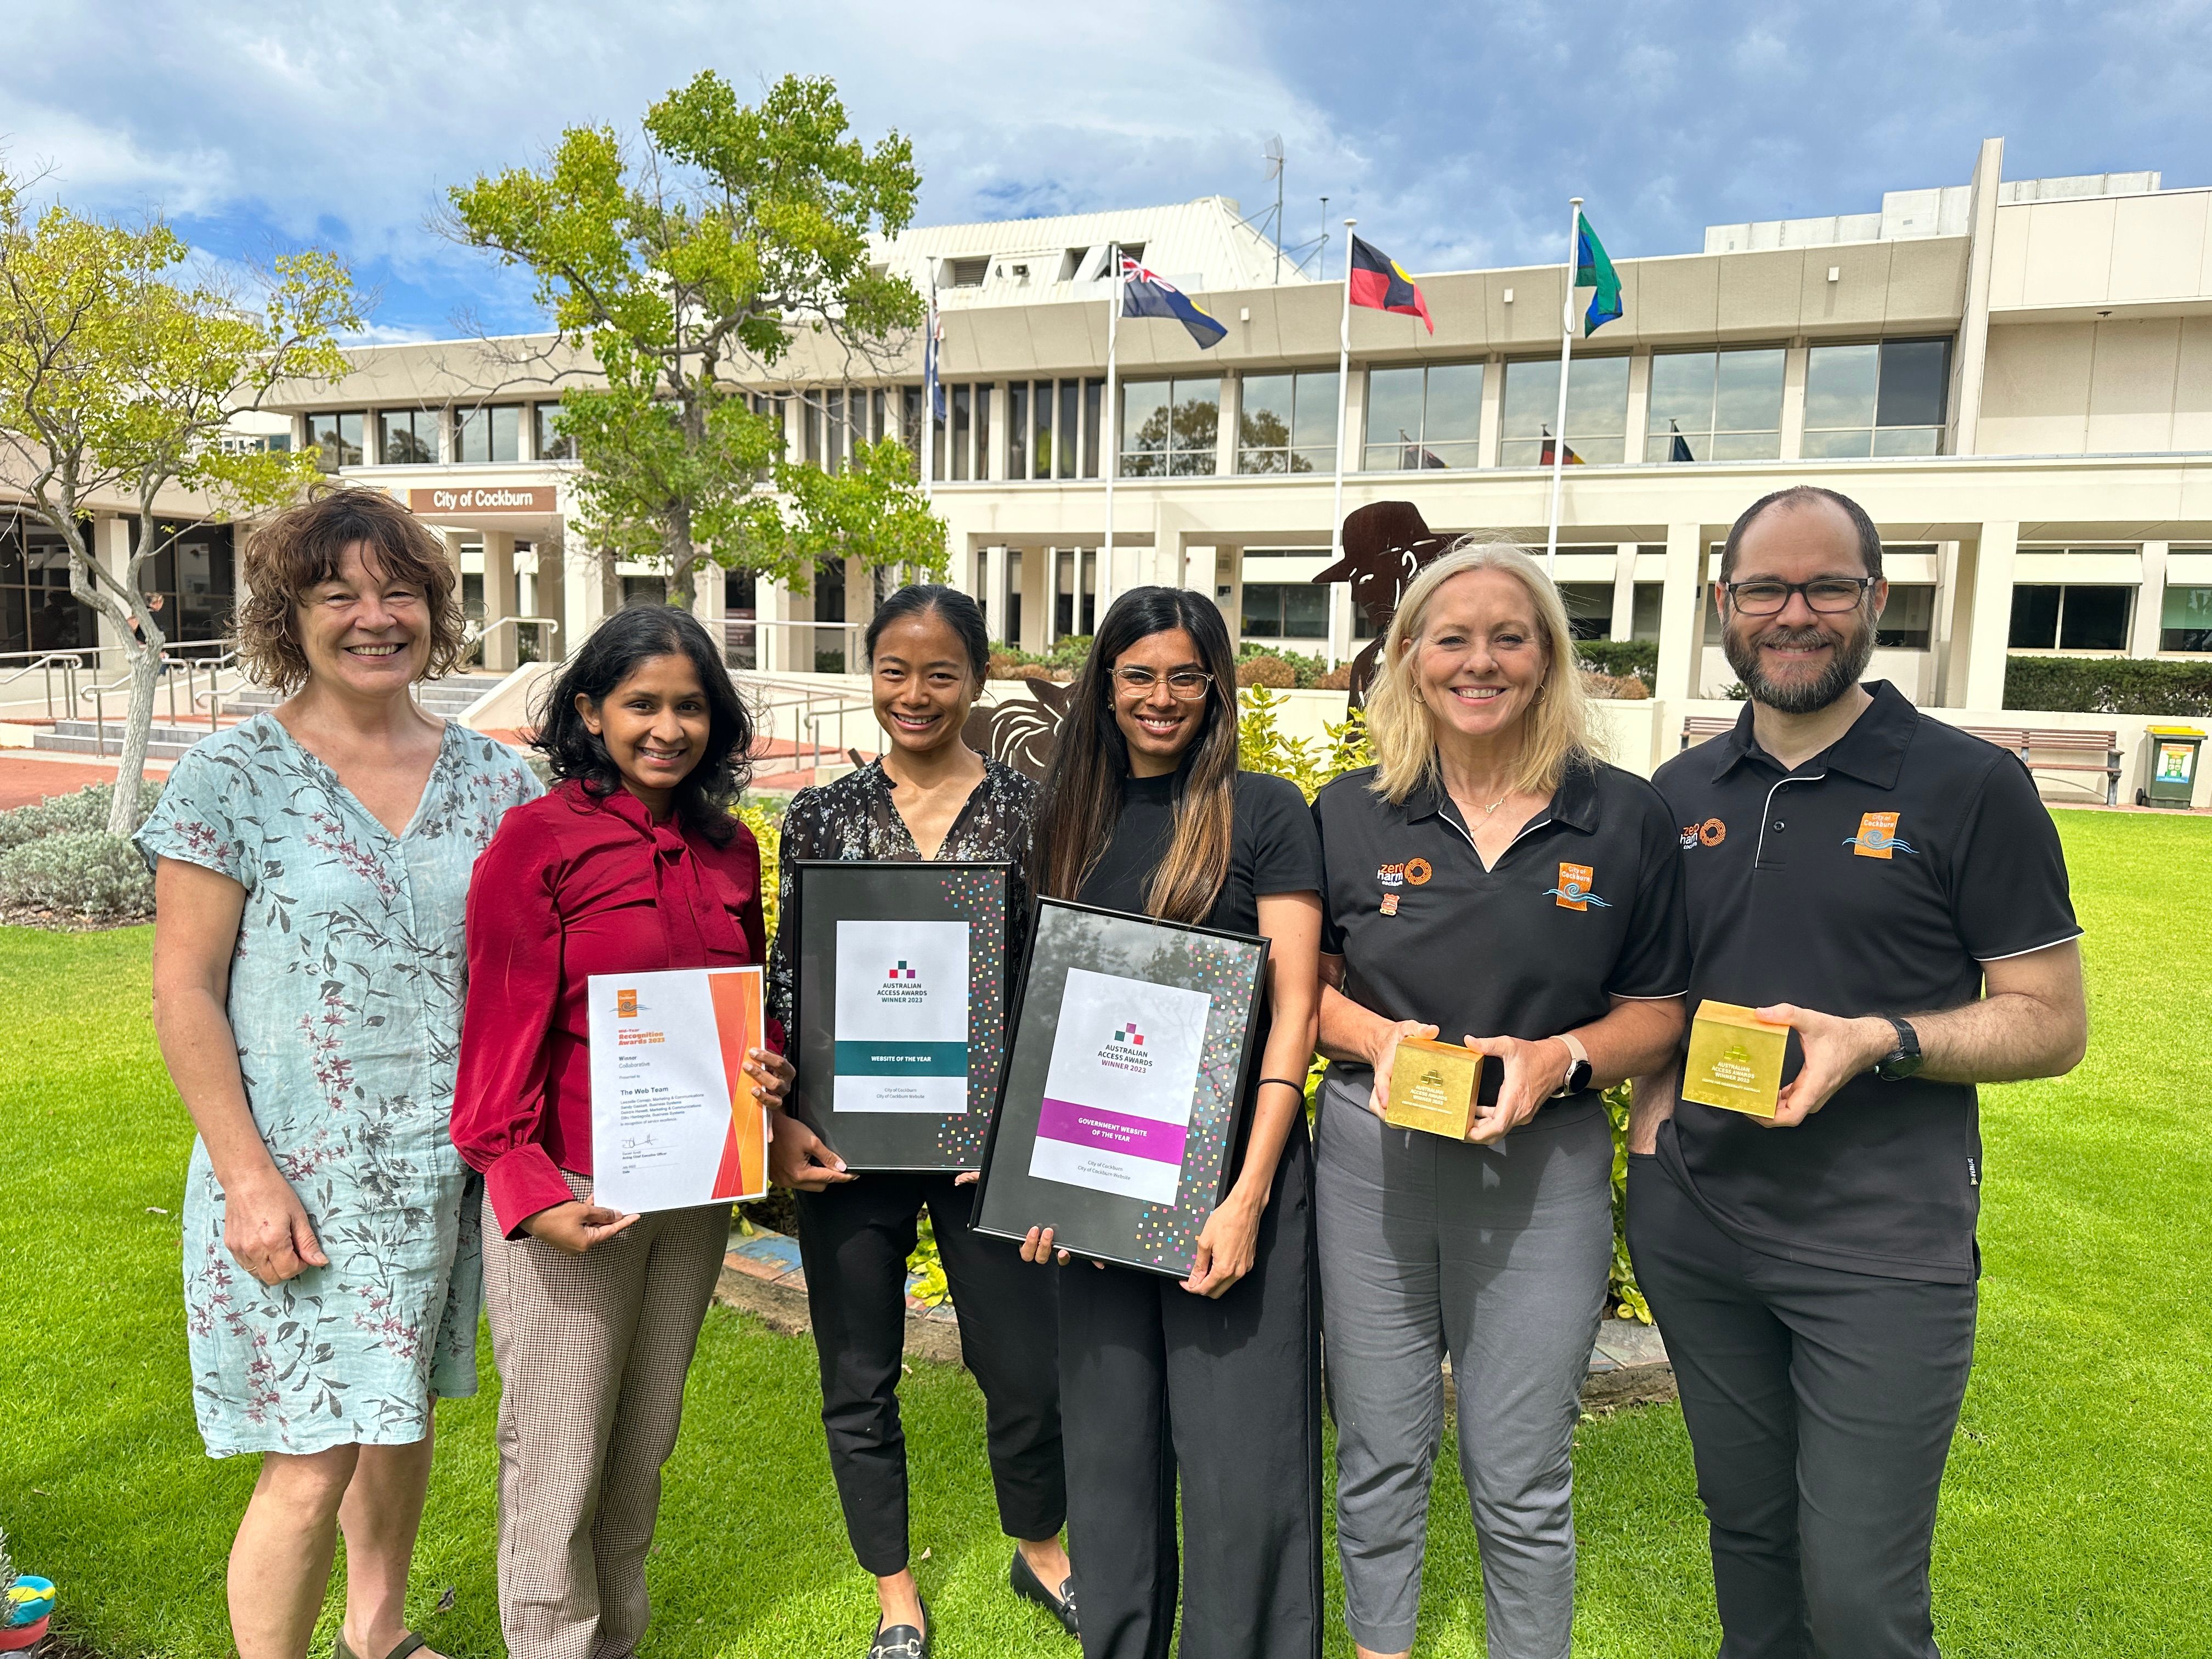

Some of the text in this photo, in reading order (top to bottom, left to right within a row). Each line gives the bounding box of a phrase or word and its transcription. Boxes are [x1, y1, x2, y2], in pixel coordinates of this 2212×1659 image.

[433, 489, 533, 510] City of Cockburn
[1864, 819, 1895, 827] Cockburn
[1380, 863, 1404, 873] zero
[1377, 870, 1403, 881] harm
[1562, 871, 1590, 882] Cockburn
[1105, 1044, 1148, 1058] AUSTRALIAN
[1098, 1051, 1153, 1066] ACCESS AWARDS
[1102, 1059, 1129, 1070] WINNER
[1718, 1062, 1750, 1072] AUSTRALIAN
[1712, 1065, 1755, 1079] ACCESS AWARDS
[1715, 1072, 1736, 1081] WINNER
[1079, 1118, 1148, 1137] GOVERNMENT WEBSITE
[1114, 1133, 1130, 1142] YEAR
[1092, 1169, 1113, 1177] Cockburn
